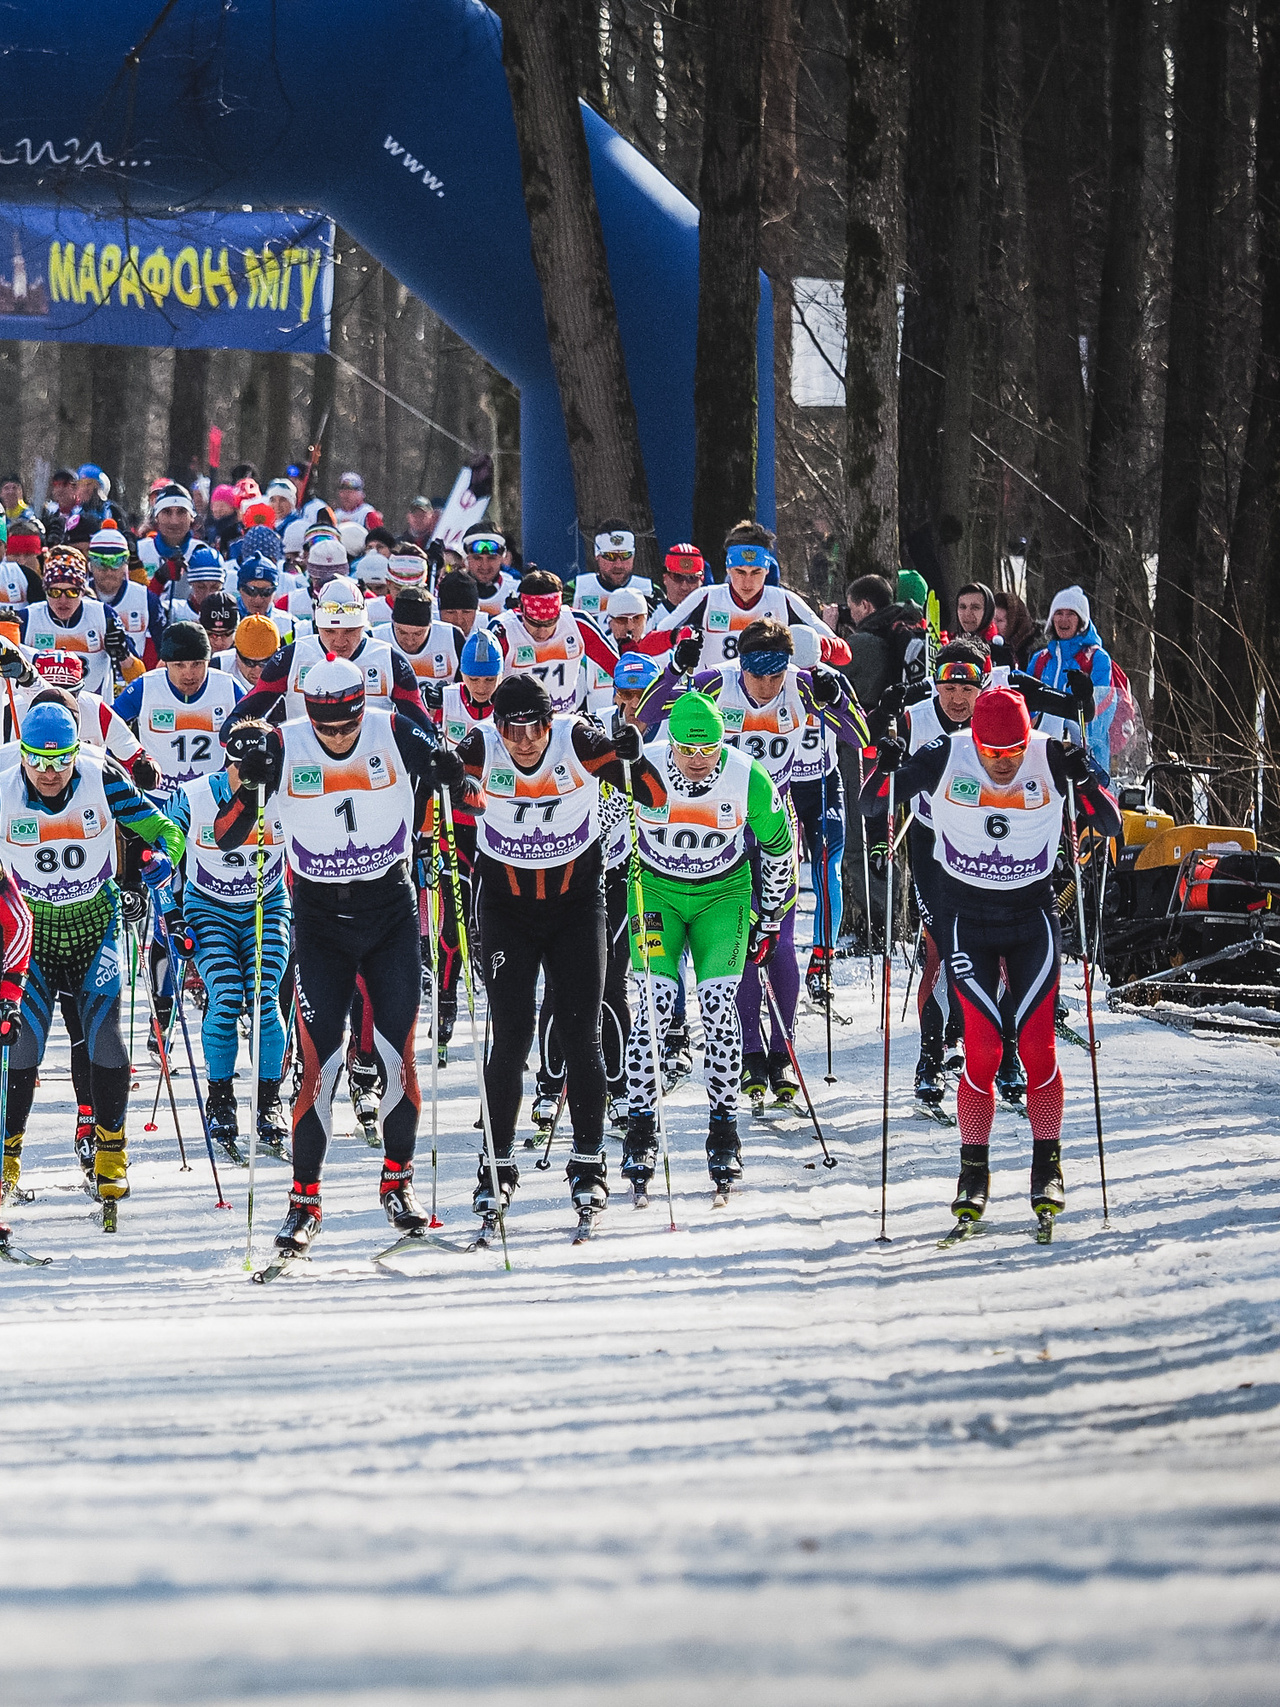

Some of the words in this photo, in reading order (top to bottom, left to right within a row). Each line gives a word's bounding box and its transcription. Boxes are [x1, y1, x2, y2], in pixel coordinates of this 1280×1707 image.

[383, 134, 446, 198] www.
[49, 240, 238, 309] МАРАФОН
[244, 246, 322, 323] МГУ
[171, 735, 213, 762] 12
[724, 734, 790, 761] 130
[334, 796, 358, 834] 1
[506, 798, 563, 824] 77
[647, 826, 729, 850] 100
[984, 813, 1012, 840] 6
[500, 835, 577, 853] МАРАФОН
[34, 843, 87, 875] 80
[310, 847, 394, 869] МАРАФОН
[339, 853, 398, 876] ЛОМОНОСОВА
[956, 856, 1036, 874] МАРАФОН
[294, 963, 311, 1009] CRAFT
